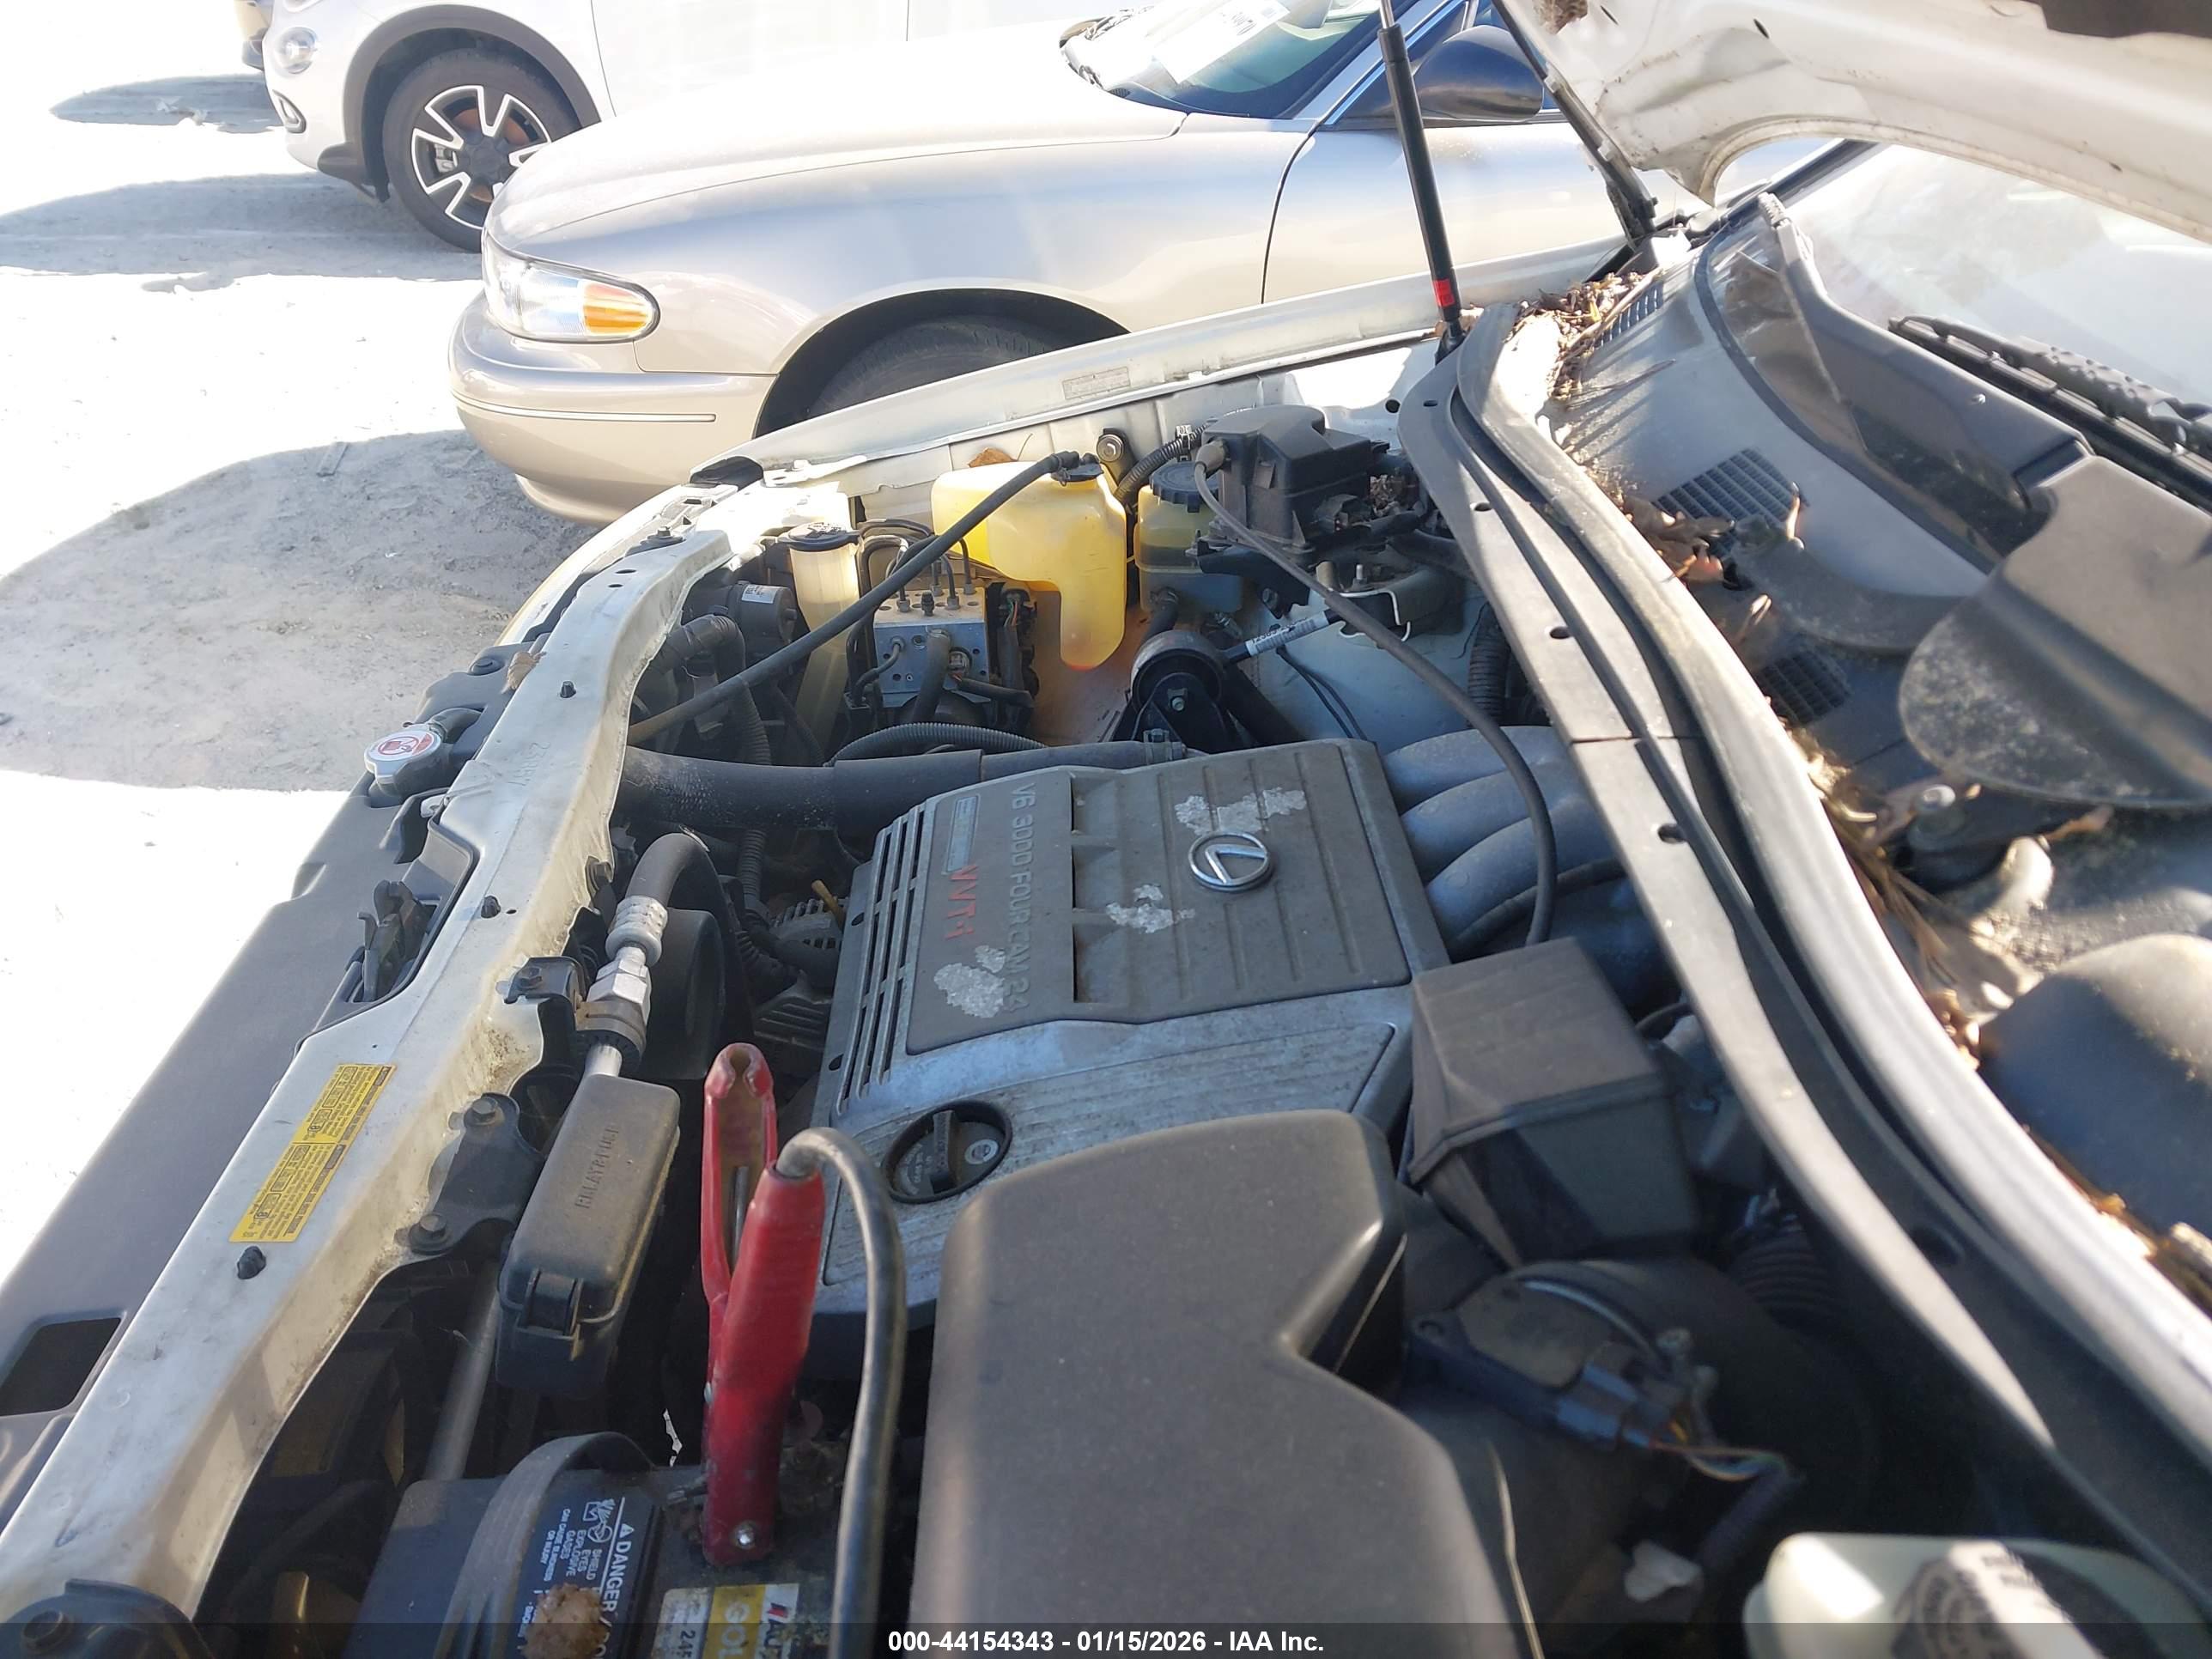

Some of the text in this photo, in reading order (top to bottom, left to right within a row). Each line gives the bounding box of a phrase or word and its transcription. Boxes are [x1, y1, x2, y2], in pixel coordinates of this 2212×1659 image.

[1012, 782, 1036, 810] V6
[1008, 871, 1031, 927] FOUR
[565, 1529, 587, 1577] EXPLOSIVE
[576, 1548, 592, 1573] EYES
[586, 1548, 603, 1581] SHIELD
[601, 1540, 633, 1613] DANGER
